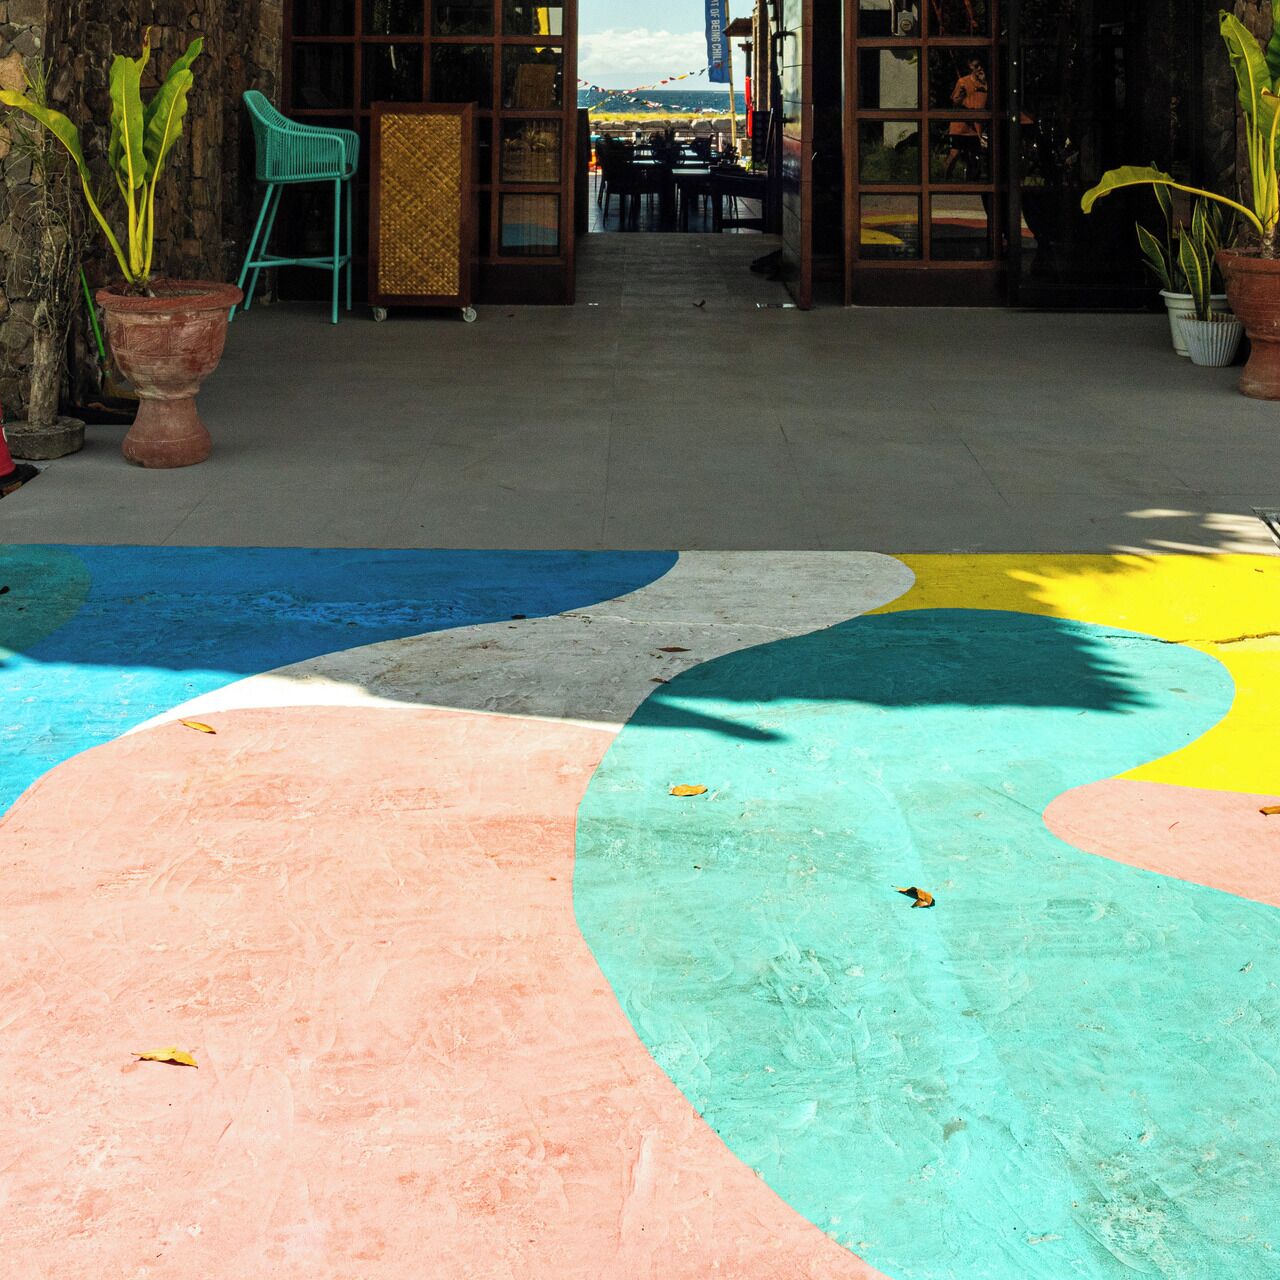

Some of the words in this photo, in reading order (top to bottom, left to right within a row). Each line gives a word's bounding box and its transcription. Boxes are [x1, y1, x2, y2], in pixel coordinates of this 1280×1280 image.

[710, 8, 720, 18] OF
[711, 19, 721, 42] BEING
[712, 42, 722, 65] CHILL
